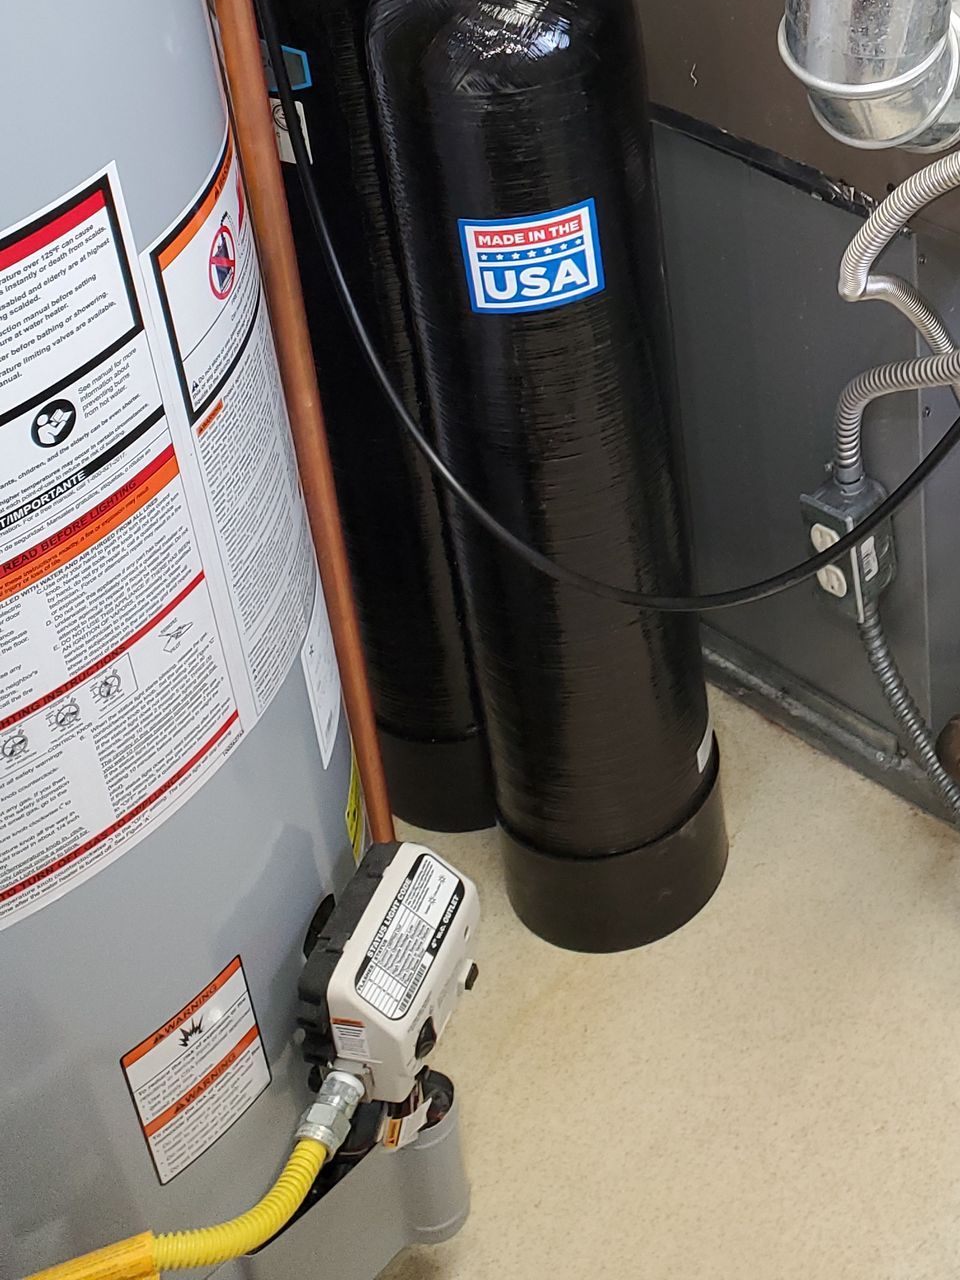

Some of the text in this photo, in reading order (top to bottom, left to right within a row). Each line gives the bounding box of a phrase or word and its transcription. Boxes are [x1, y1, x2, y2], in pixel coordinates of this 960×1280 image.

[23, 259, 40, 272] over
[61, 238, 74, 249] can
[74, 224, 94, 240] cause
[478, 220, 580, 246] MADE IN THE
[5, 270, 37, 292] instantly
[39, 265, 47, 273] or
[48, 252, 68, 267] death
[68, 241, 84, 254] from
[28, 282, 42, 295] and
[44, 268, 67, 286] elderly
[68, 260, 79, 271] are
[80, 254, 87, 263] at
[87, 238, 110, 257] highest
[482, 258, 588, 300] USA
[9, 294, 41, 316] scalded.
[14, 331, 22, 339] at
[23, 318, 44, 333] water
[45, 302, 69, 320] heater.
[23, 304, 50, 324] manual
[51, 290, 74, 307] before
[74, 274, 96, 292] setting
[10, 339, 35, 356] before
[37, 321, 64, 341] bathing
[65, 315, 73, 323] or
[73, 292, 109, 318] showering.
[23, 344, 51, 364] limiting
[52, 330, 74, 346] valves
[76, 321, 86, 332] are
[87, 301, 116, 324] available.
[78, 348, 137, 394] See manual for more
[80, 363, 130, 402] information about
[82, 387, 114, 412] preventing
[84, 408, 99, 419] from
[99, 400, 110, 410] hot
[47, 452, 59, 463] and
[59, 446, 69, 455] the
[70, 432, 90, 447] elderly
[90, 424, 101, 434] can
[20, 468, 60, 494] temperatures
[61, 460, 73, 470] may
[74, 449, 90, 462] occur
[2, 480, 137, 573] READ BEFORE LIGHTING
[367, 876, 412, 958] STATUS LIGHT CODE
[443, 896, 459, 924] OUTLET
[164, 984, 217, 1033] WARNING
[185, 1052, 236, 1102] WARNING
